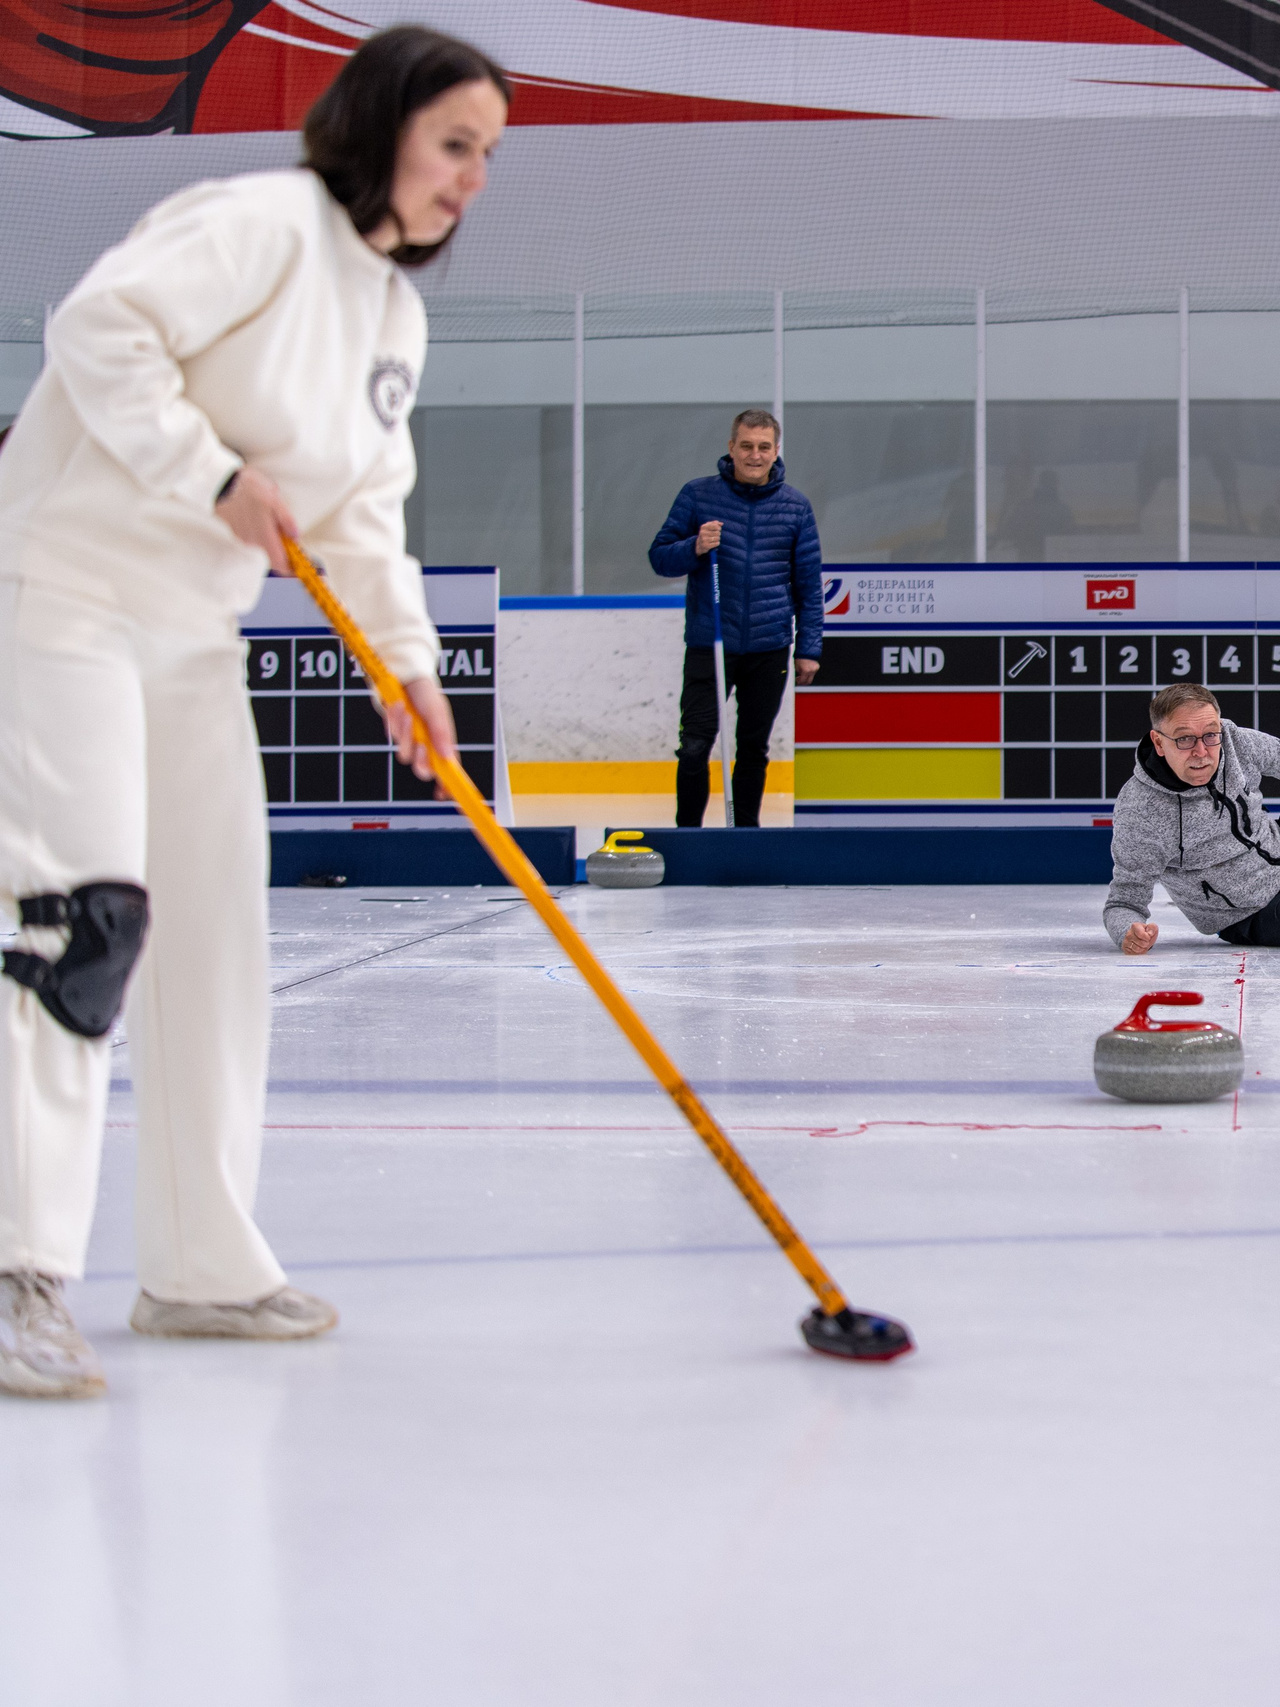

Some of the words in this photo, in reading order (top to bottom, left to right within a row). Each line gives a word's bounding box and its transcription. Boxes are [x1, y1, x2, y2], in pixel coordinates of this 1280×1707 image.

[857, 580, 935, 590] ФЕДЕРАЦИЯ
[857, 590, 935, 603] КЁРЛИНГА
[857, 604, 935, 614] РОССИИ
[260, 650, 279, 679] 9
[299, 650, 338, 678] 10
[438, 648, 492, 677] TAL
[882, 646, 945, 674] END
[1070, 646, 1088, 673] 1
[1120, 645, 1139, 673] 2
[1172, 648, 1191, 676] 3
[1219, 645, 1241, 673] 4
